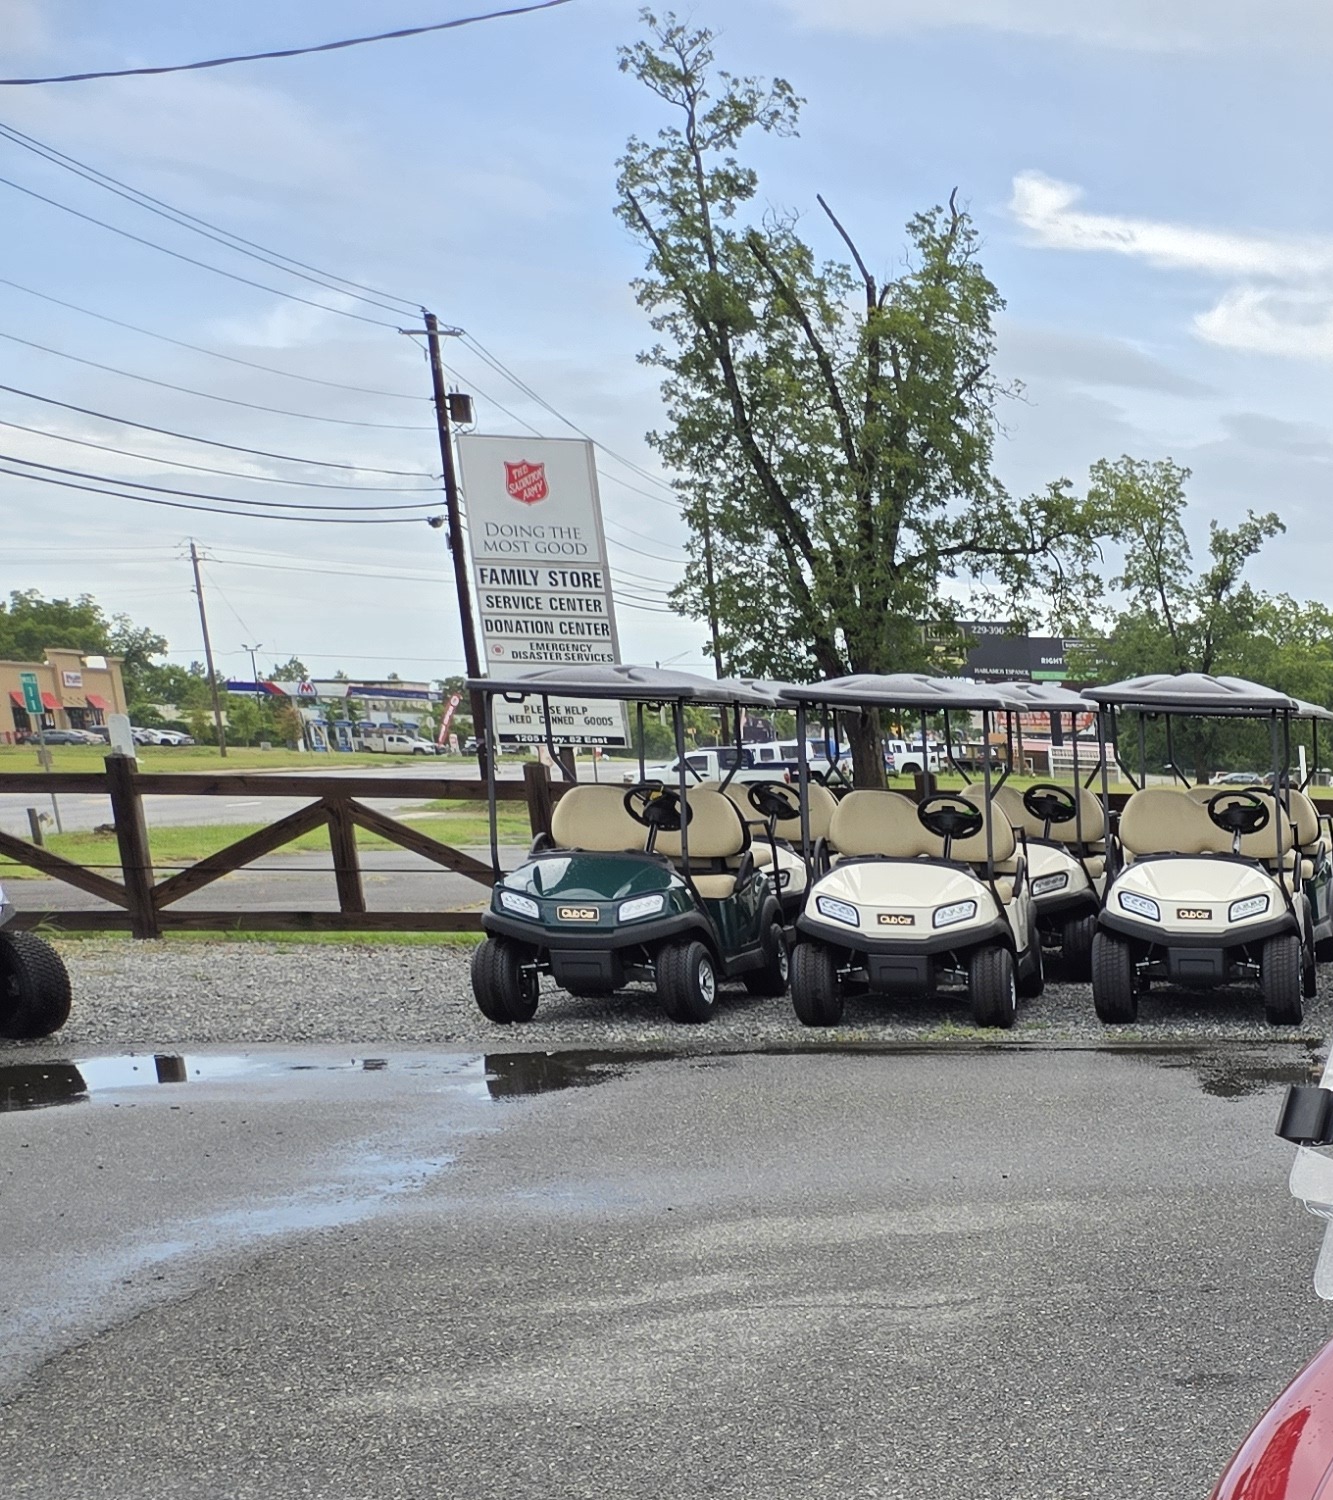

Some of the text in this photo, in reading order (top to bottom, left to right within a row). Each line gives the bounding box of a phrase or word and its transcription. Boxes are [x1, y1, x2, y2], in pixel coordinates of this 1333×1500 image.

[485, 522, 582, 540] DOING THE
[483, 540, 588, 556] MOST GOOD
[479, 568, 603, 589] FAMILY STORE
[485, 594, 603, 613] SERVICE CENTER
[485, 618, 610, 637] DONATION CENTER
[529, 642, 593, 653] EMERGENCY
[511, 650, 614, 663] DISASTER SERVICES
[1040, 657, 1063, 665] RIGHT
[523, 705, 588, 716] PLESE HELP
[508, 714, 614, 726] NEED CNNED GOODS
[515, 734, 540, 743] 1205
[584, 736, 608, 744] East
